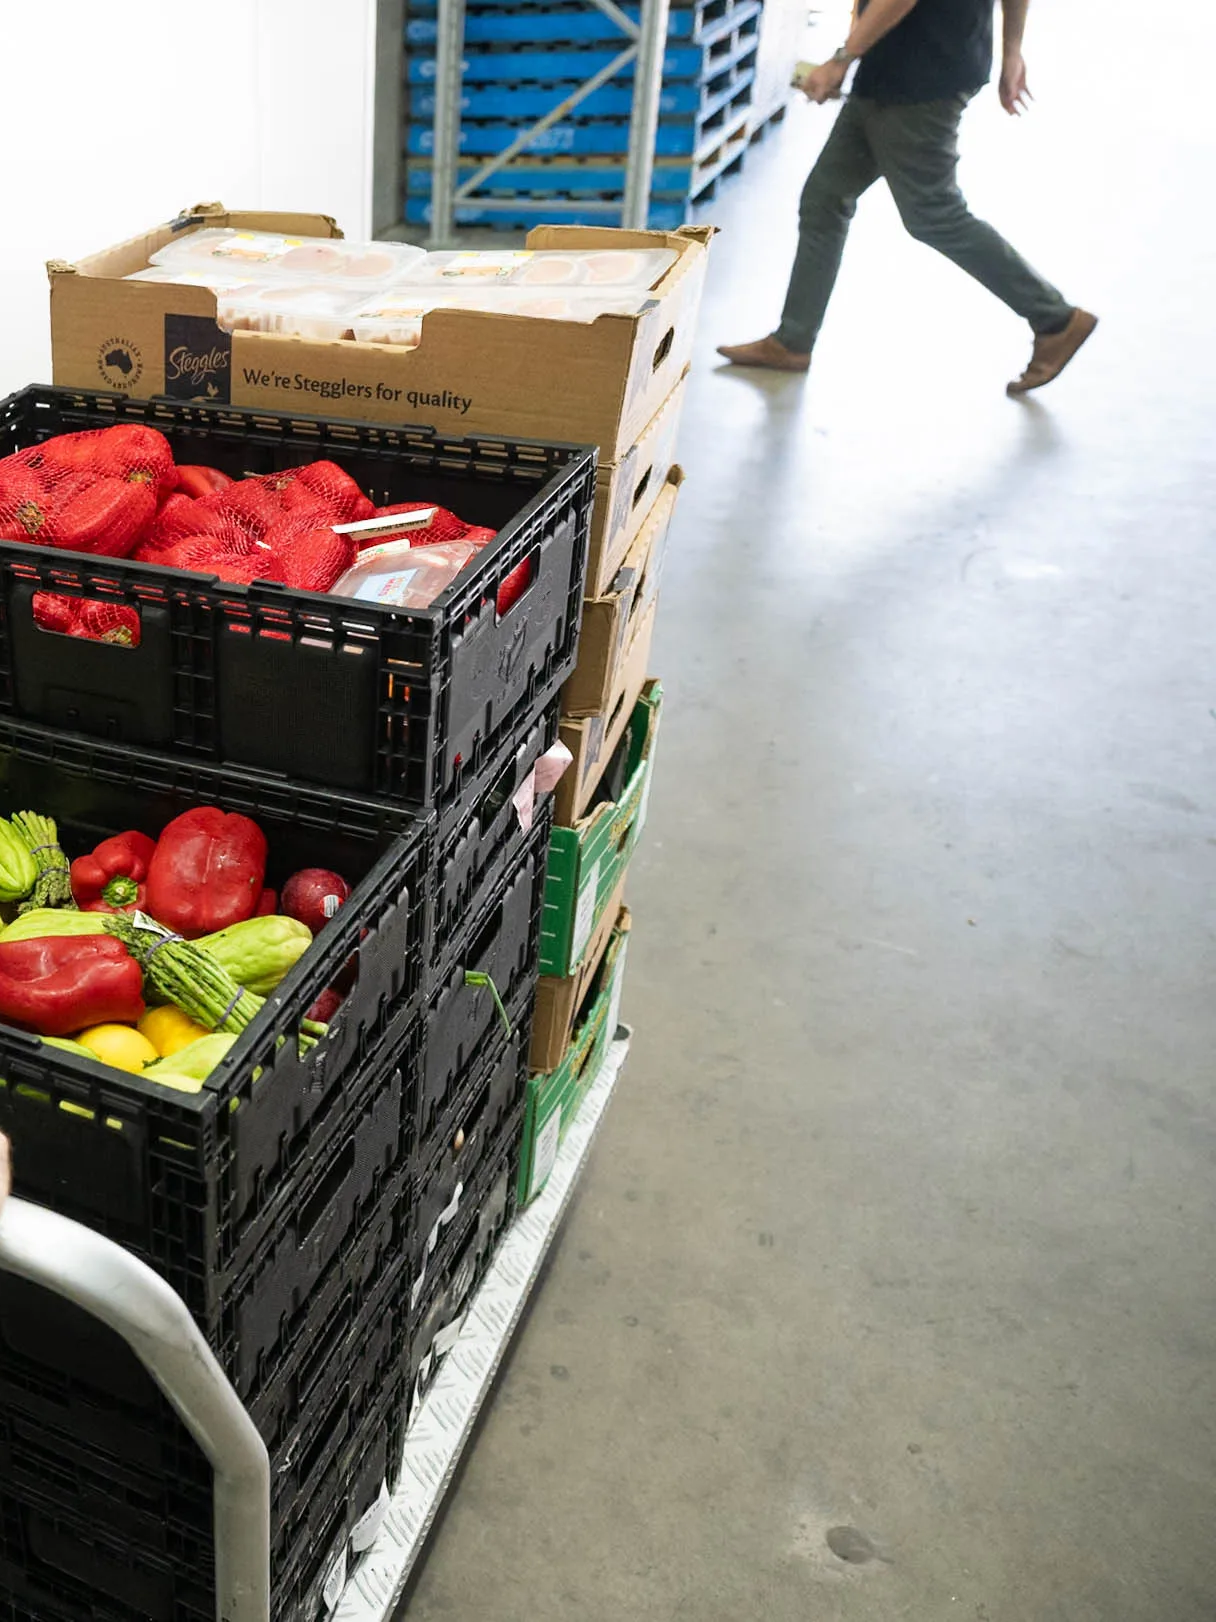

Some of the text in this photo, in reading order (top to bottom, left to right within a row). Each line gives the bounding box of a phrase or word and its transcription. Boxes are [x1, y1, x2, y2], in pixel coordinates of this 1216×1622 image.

[167, 345, 230, 385] Steggles
[242, 368, 473, 415] We're Stegglers for quality
